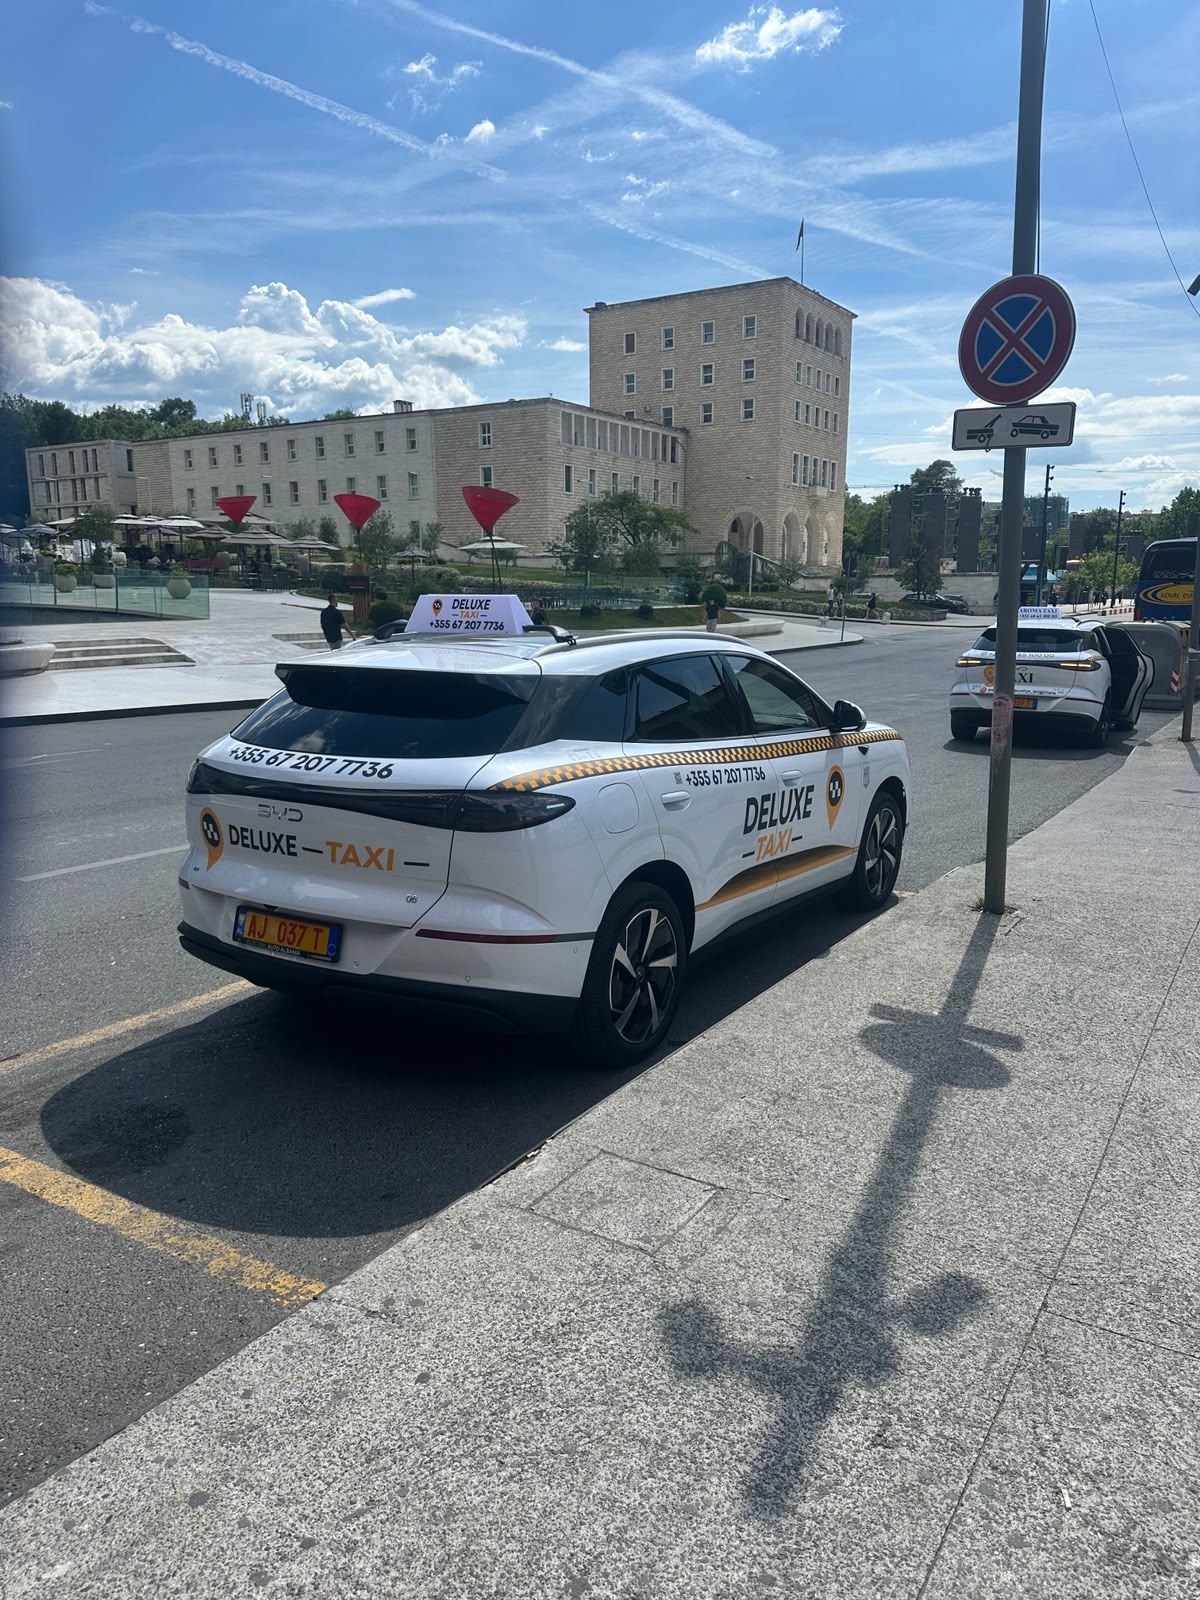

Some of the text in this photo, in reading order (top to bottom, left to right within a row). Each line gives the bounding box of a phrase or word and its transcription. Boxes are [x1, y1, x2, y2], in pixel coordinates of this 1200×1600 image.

[452, 599, 491, 610] DELUXE
[459, 610, 480, 619] TAXI
[429, 620, 505, 631] +355 67 207 7736
[228, 747, 395, 780] +355 67 207 7736
[685, 766, 766, 787] +355 67 207 7736
[257, 803, 304, 823] BYD
[743, 784, 815, 835] DELUXE
[228, 824, 395, 872] DELUXE TAXI
[755, 828, 793, 862] TAXI
[405, 893, 418, 904] 06
[247, 914, 323, 951] AJ 037 T
[267, 944, 280, 952] AUTO
[280, 946, 301, 956] ALBANIA
